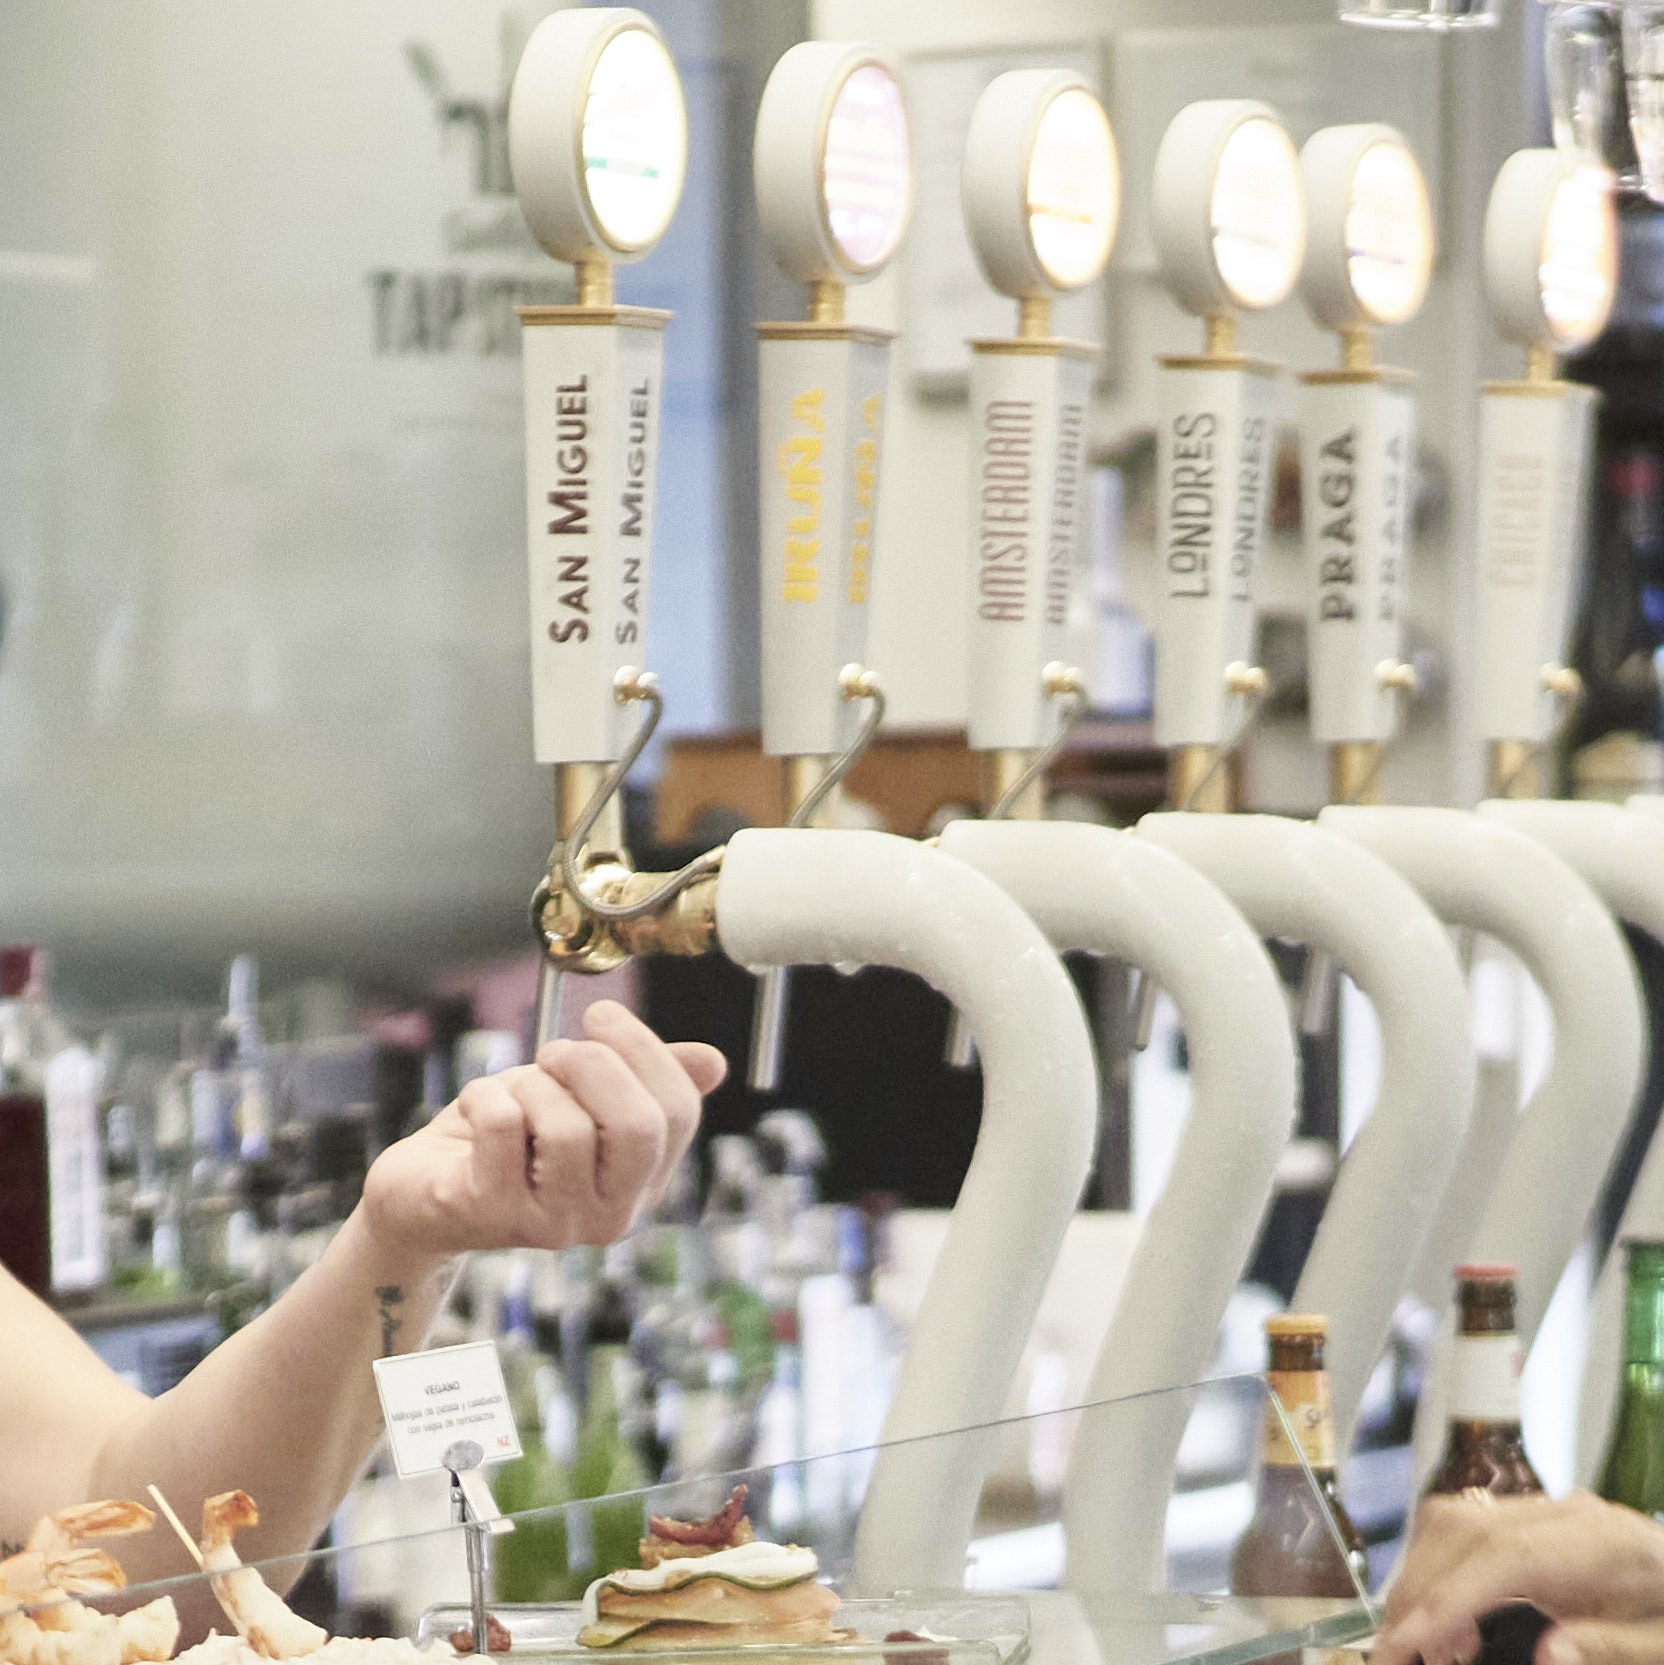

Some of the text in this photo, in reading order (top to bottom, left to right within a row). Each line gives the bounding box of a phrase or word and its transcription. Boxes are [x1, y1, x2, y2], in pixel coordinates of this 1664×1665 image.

[546, 373, 591, 645] SAN MIGUEL
[614, 377, 651, 646] SAN MIGUEL
[977, 401, 1034, 623] AMSTERDAM
[1166, 411, 1218, 600] LONDRES
[1320, 423, 1358, 622] PRAGA
[423, 1380, 461, 1396] VEGANO
